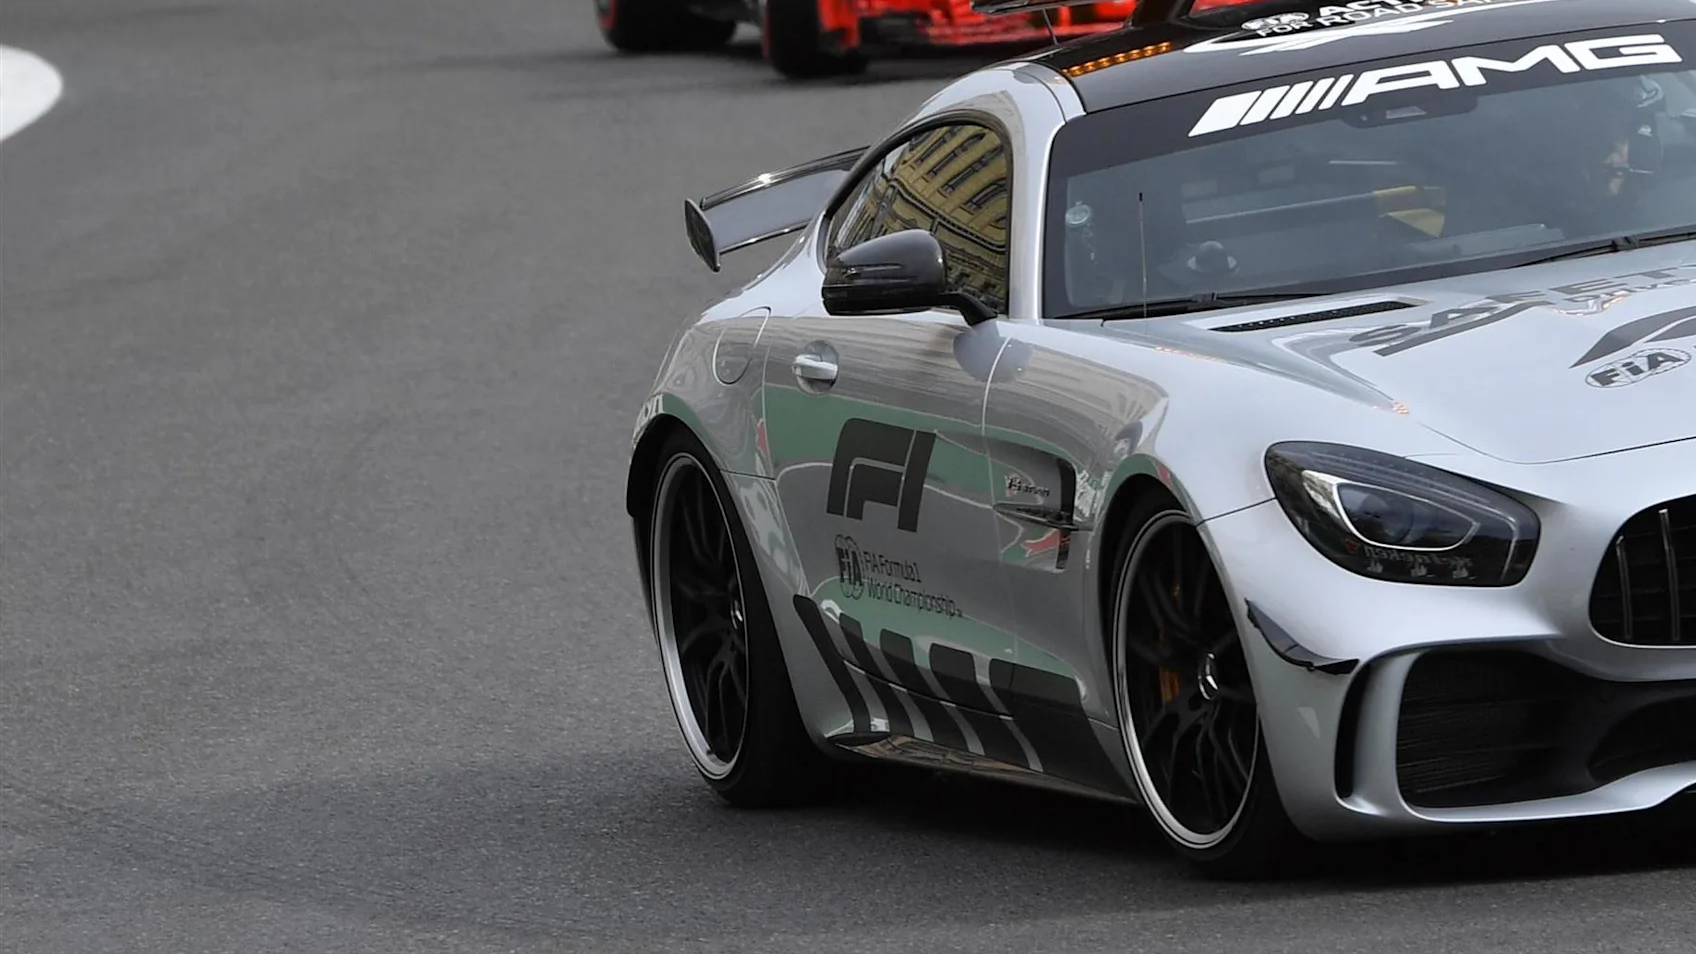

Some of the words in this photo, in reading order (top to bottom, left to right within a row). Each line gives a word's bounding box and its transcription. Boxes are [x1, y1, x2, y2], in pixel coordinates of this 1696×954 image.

[1256, 21, 1313, 37] FOR
[1317, 3, 1419, 28] ROAD
[1341, 34, 1682, 106] AMG
[863, 551, 880, 574] FIA
[880, 555, 915, 582] Formula
[914, 561, 922, 583] 1
[867, 578, 892, 603] World
[893, 584, 956, 619] Championship
